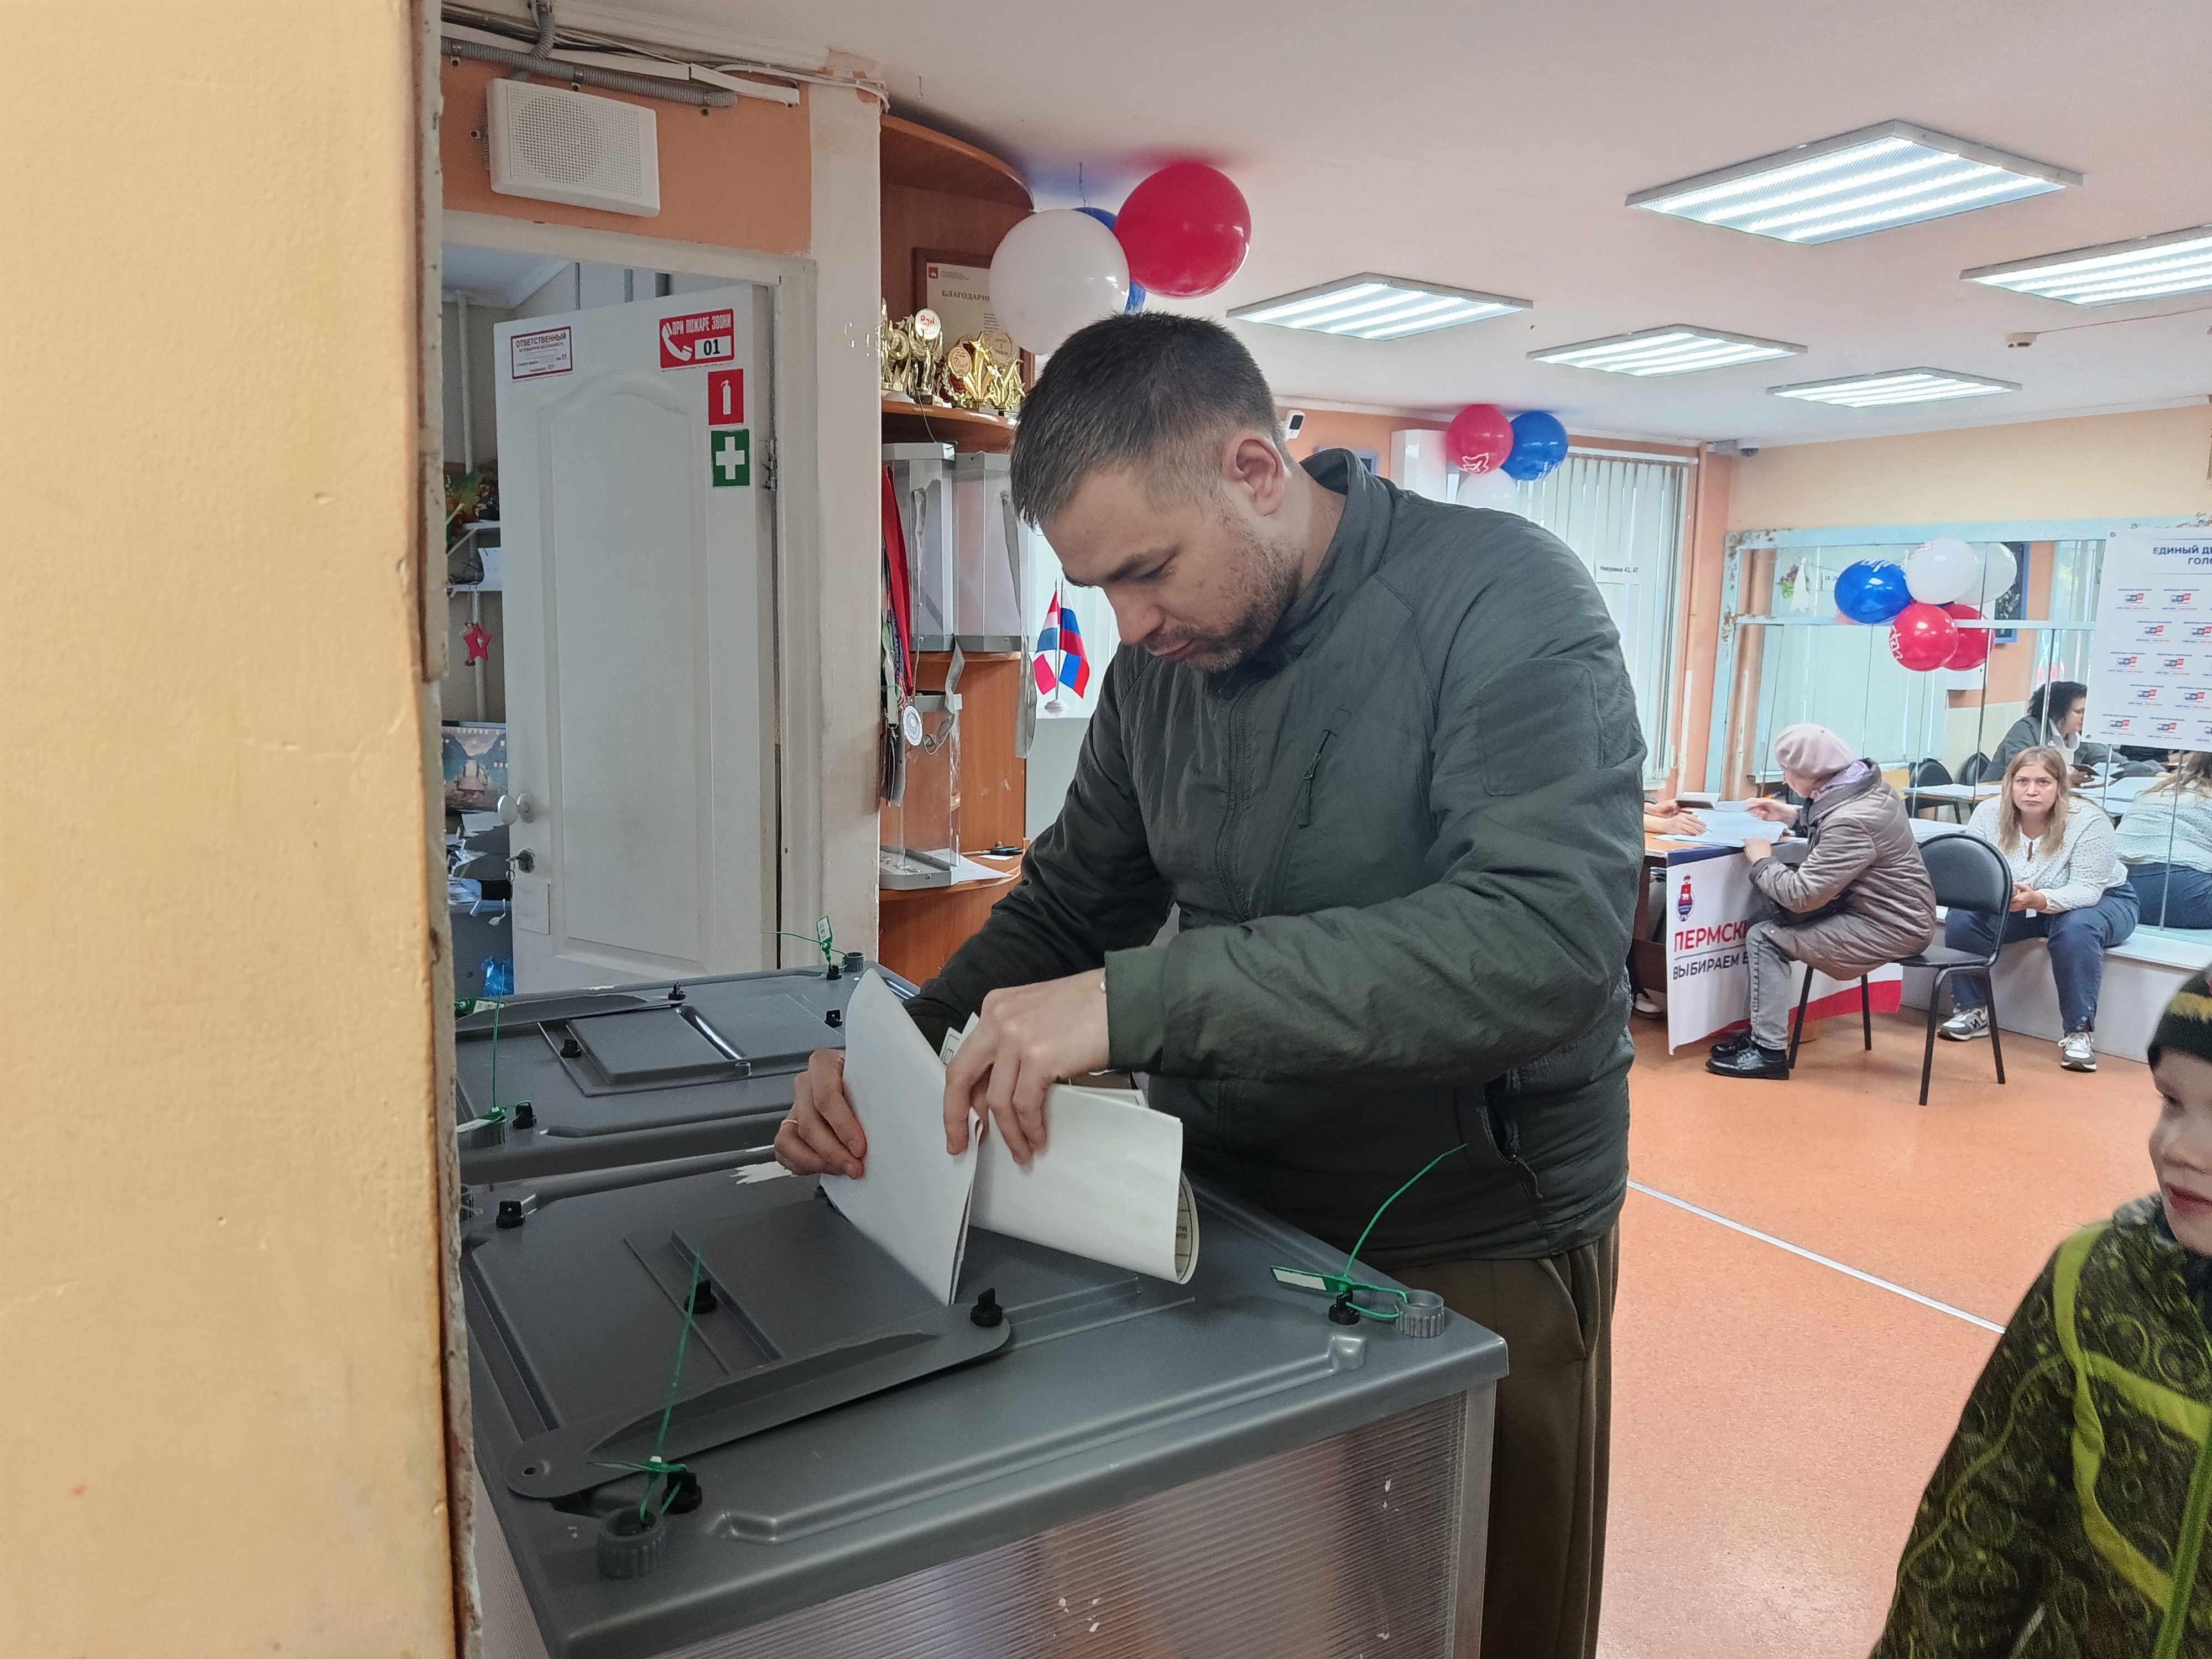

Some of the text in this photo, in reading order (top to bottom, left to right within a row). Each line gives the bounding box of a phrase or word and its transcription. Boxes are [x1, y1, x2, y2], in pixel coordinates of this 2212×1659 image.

[672, 314, 731, 335] ПРИ ПОЖАРЕ ЗВОНИ
[515, 331, 566, 348] ОТВЕТСТВЕННЫЙ
[703, 338, 721, 356] 01
[2152, 544, 2199, 555] ЕДИНЫЙ
[1673, 952, 1740, 980] ВЫБИРАЕМ
